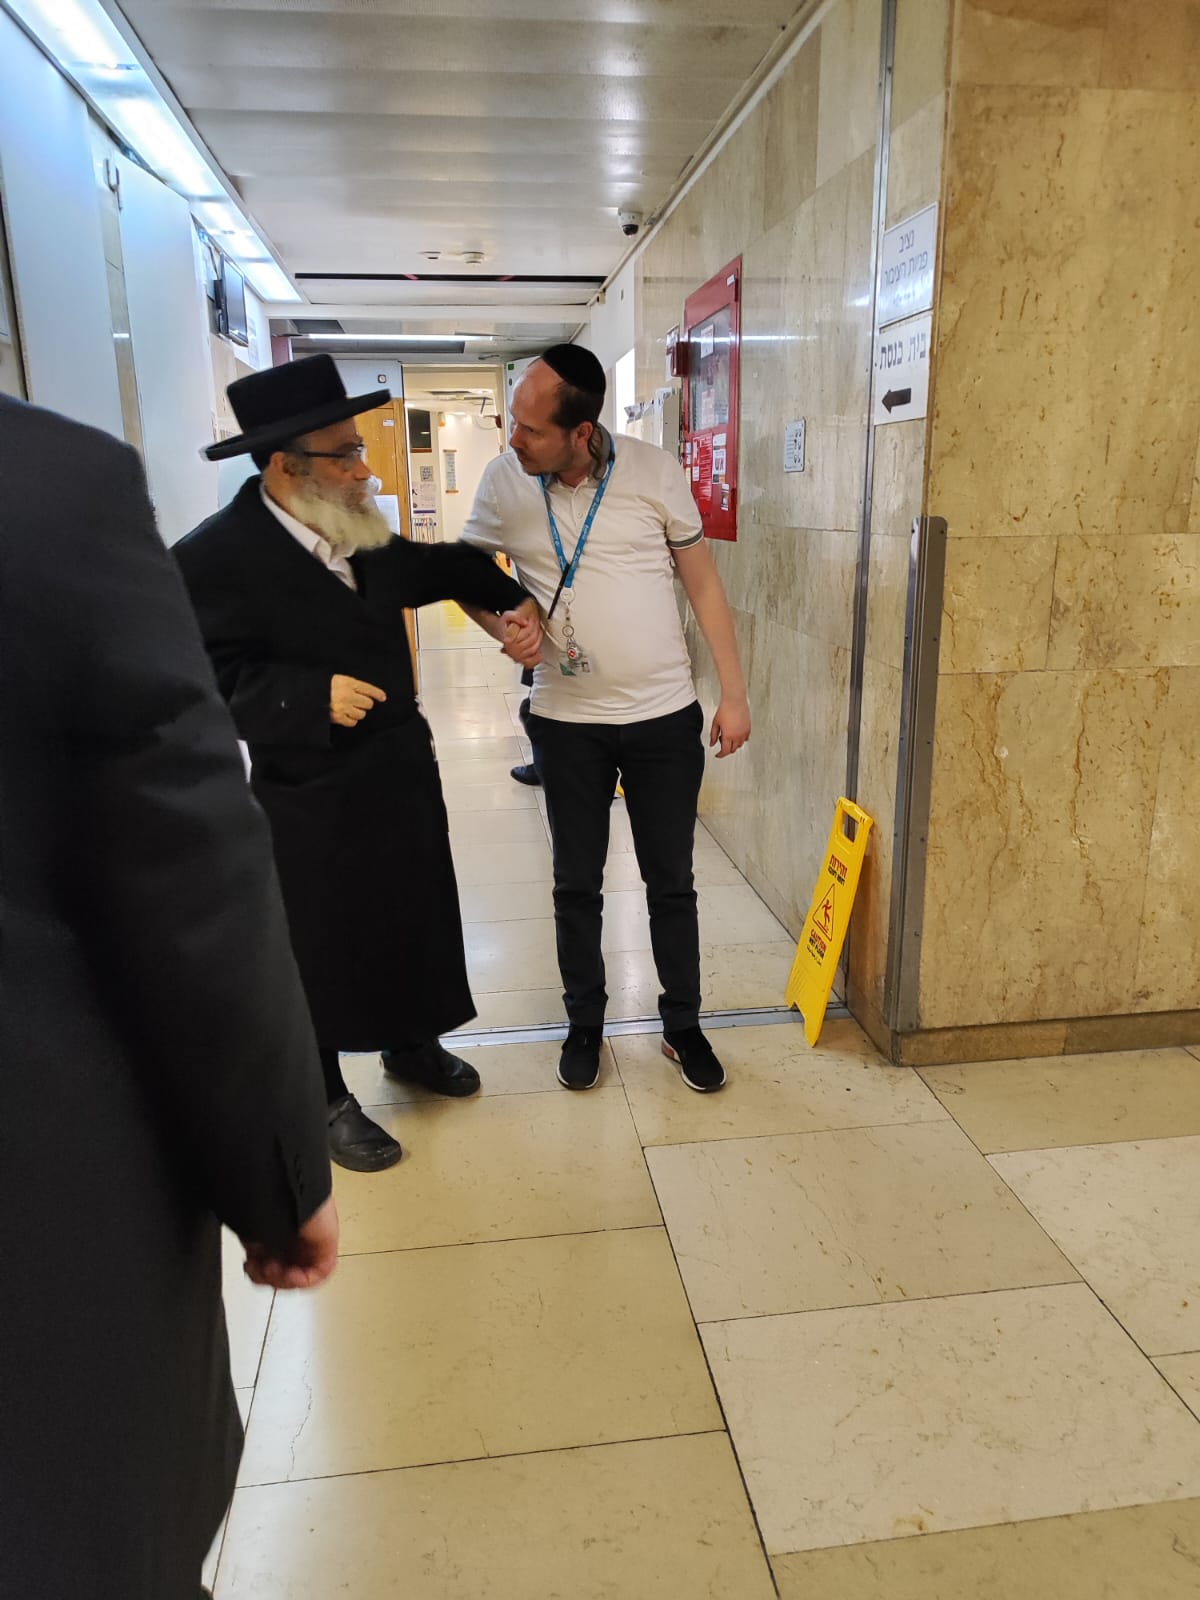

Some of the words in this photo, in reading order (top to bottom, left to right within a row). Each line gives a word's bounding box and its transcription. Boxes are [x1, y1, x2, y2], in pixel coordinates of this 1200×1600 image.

[880, 341, 904, 370] כנסת
[908, 333, 926, 361] בית
[829, 854, 848, 878] זהירות
